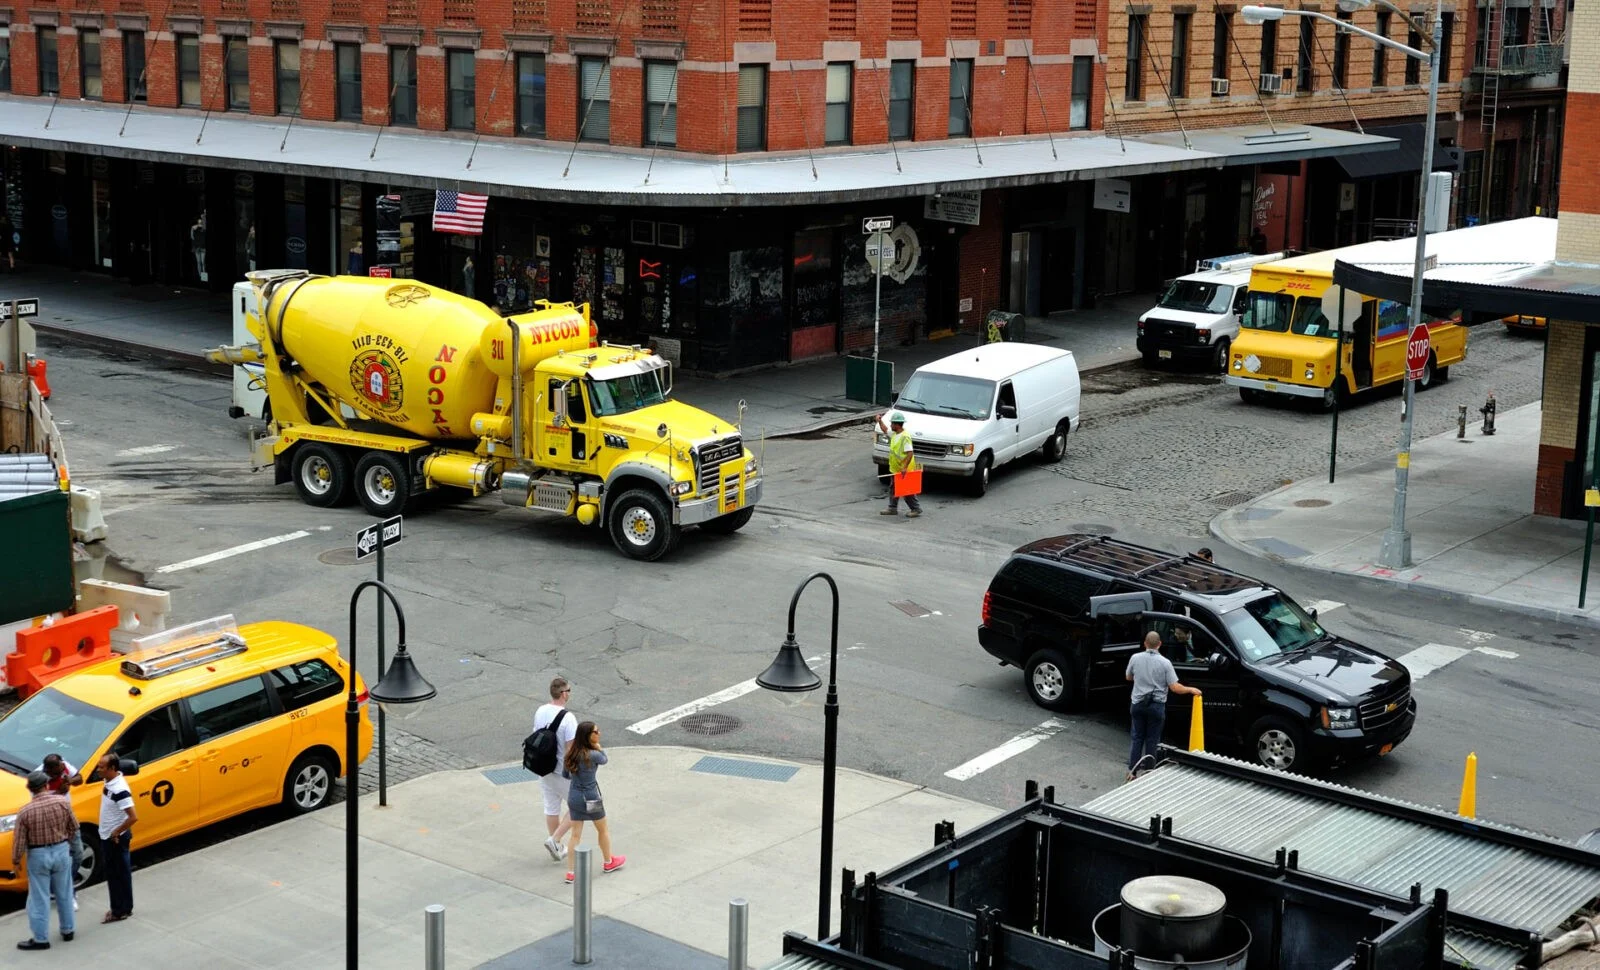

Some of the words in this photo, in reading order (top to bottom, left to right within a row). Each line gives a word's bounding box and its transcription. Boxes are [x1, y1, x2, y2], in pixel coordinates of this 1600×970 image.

[1287, 281, 1311, 291] DHL
[18, 304, 32, 313] WAY
[528, 318, 581, 346] NYCON
[491, 338, 505, 361] 311
[1408, 338, 1429, 360] STOP
[704, 446, 738, 462] MACK
[362, 533, 376, 548] ONE
[383, 526, 398, 539] WAY
